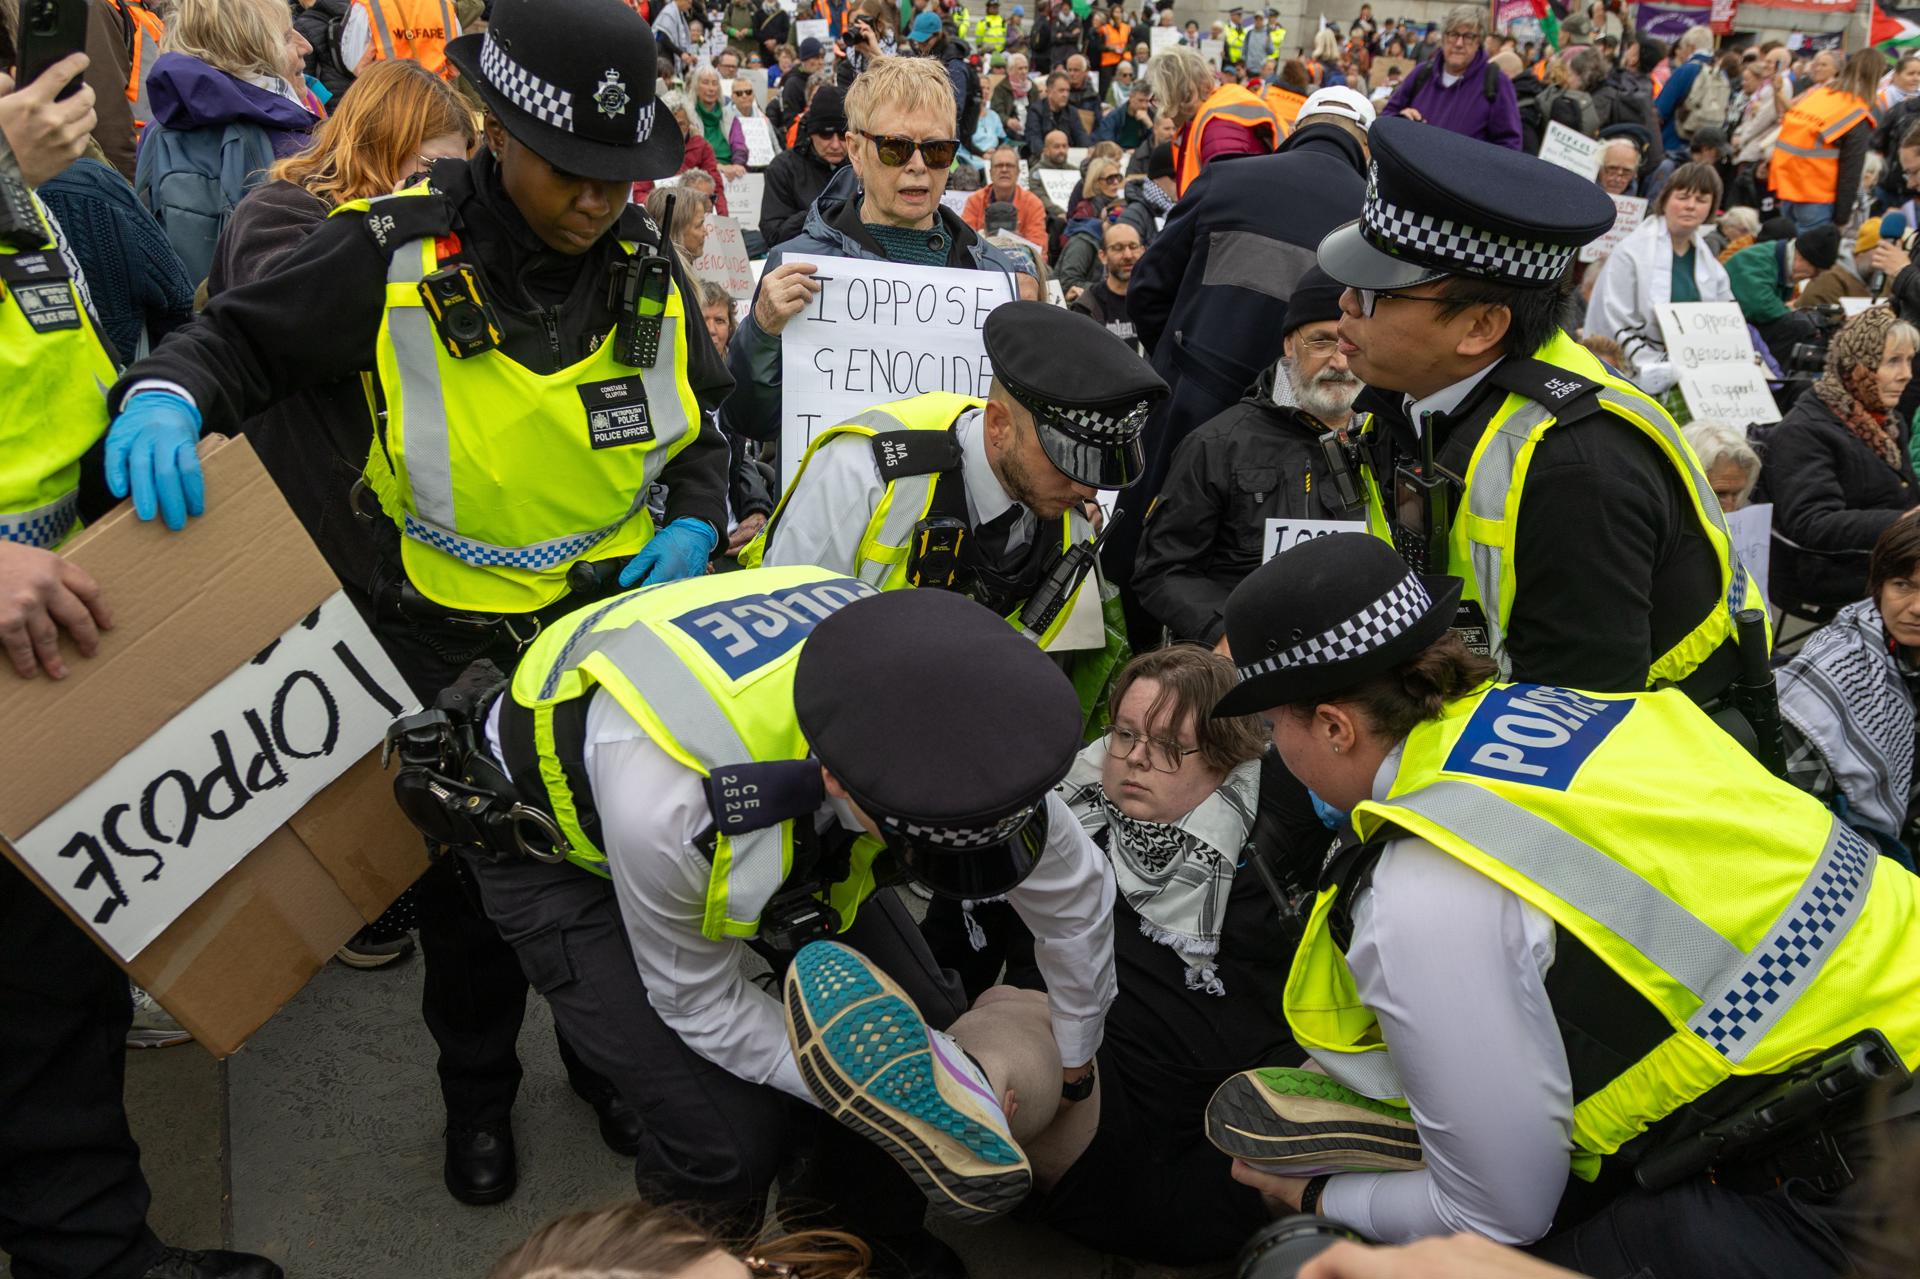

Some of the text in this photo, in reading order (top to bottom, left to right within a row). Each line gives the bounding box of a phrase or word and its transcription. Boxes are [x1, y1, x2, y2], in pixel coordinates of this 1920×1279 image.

[368, 215, 388, 247] 2842
[380, 215, 396, 232] CE
[807, 276, 994, 330] I OPPOSE
[814, 347, 994, 399] GENOCIDE
[600, 384, 628, 394] CONSTABLE
[1544, 378, 1566, 390] CE
[1551, 382, 1582, 399] 2355
[611, 407, 642, 418] METROPOLITAN
[617, 414, 640, 425] POLICE
[594, 425, 650, 442] POLICE OFFICER
[881, 440, 898, 467] 3445
[895, 443, 909, 459] NA
[57, 640, 408, 925] I OPPOSE
[721, 775, 743, 823] 2520
[742, 784, 760, 809] CE
